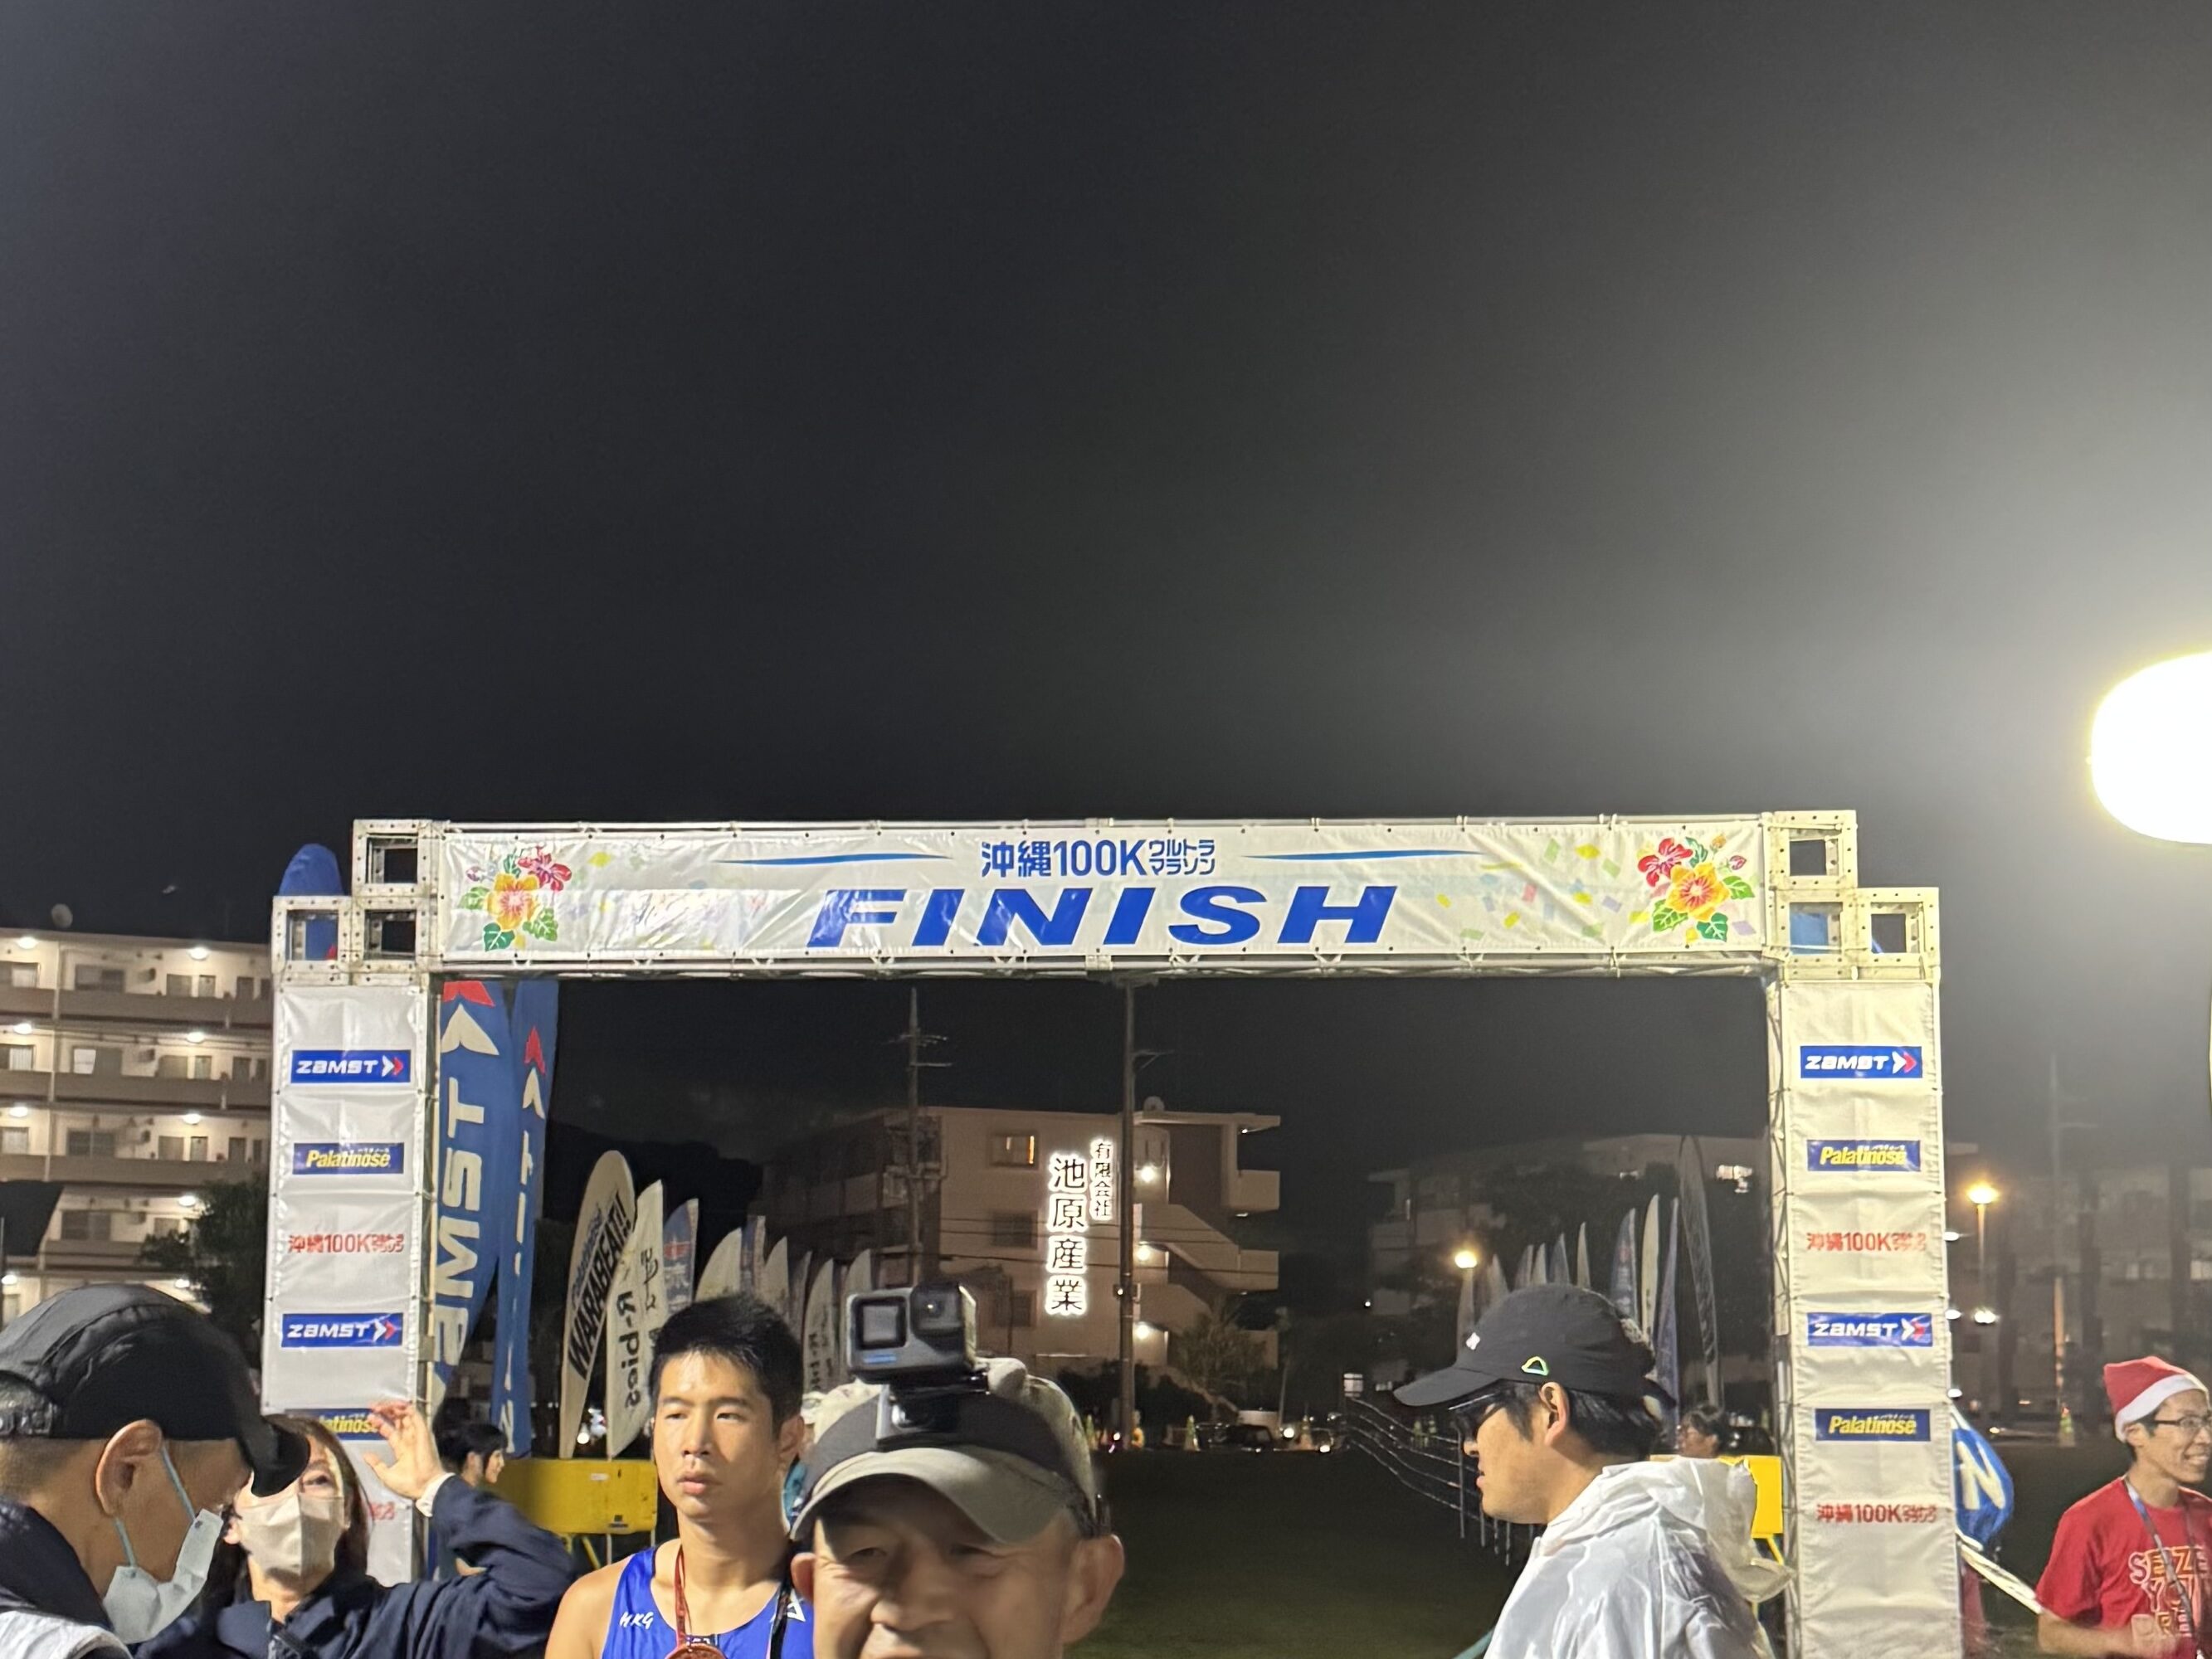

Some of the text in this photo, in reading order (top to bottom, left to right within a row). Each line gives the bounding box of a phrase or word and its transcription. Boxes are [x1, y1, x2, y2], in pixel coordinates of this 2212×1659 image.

[806, 885, 1397, 947] FINISH
[305, 1149, 391, 1168] Palatinose
[1094, 1142, 1111, 1217] 有限会社
[1050, 1157, 1085, 1311] 池原産業
[1829, 1415, 1917, 1434] Palatinose
[619, 1612, 654, 1628] HKG
